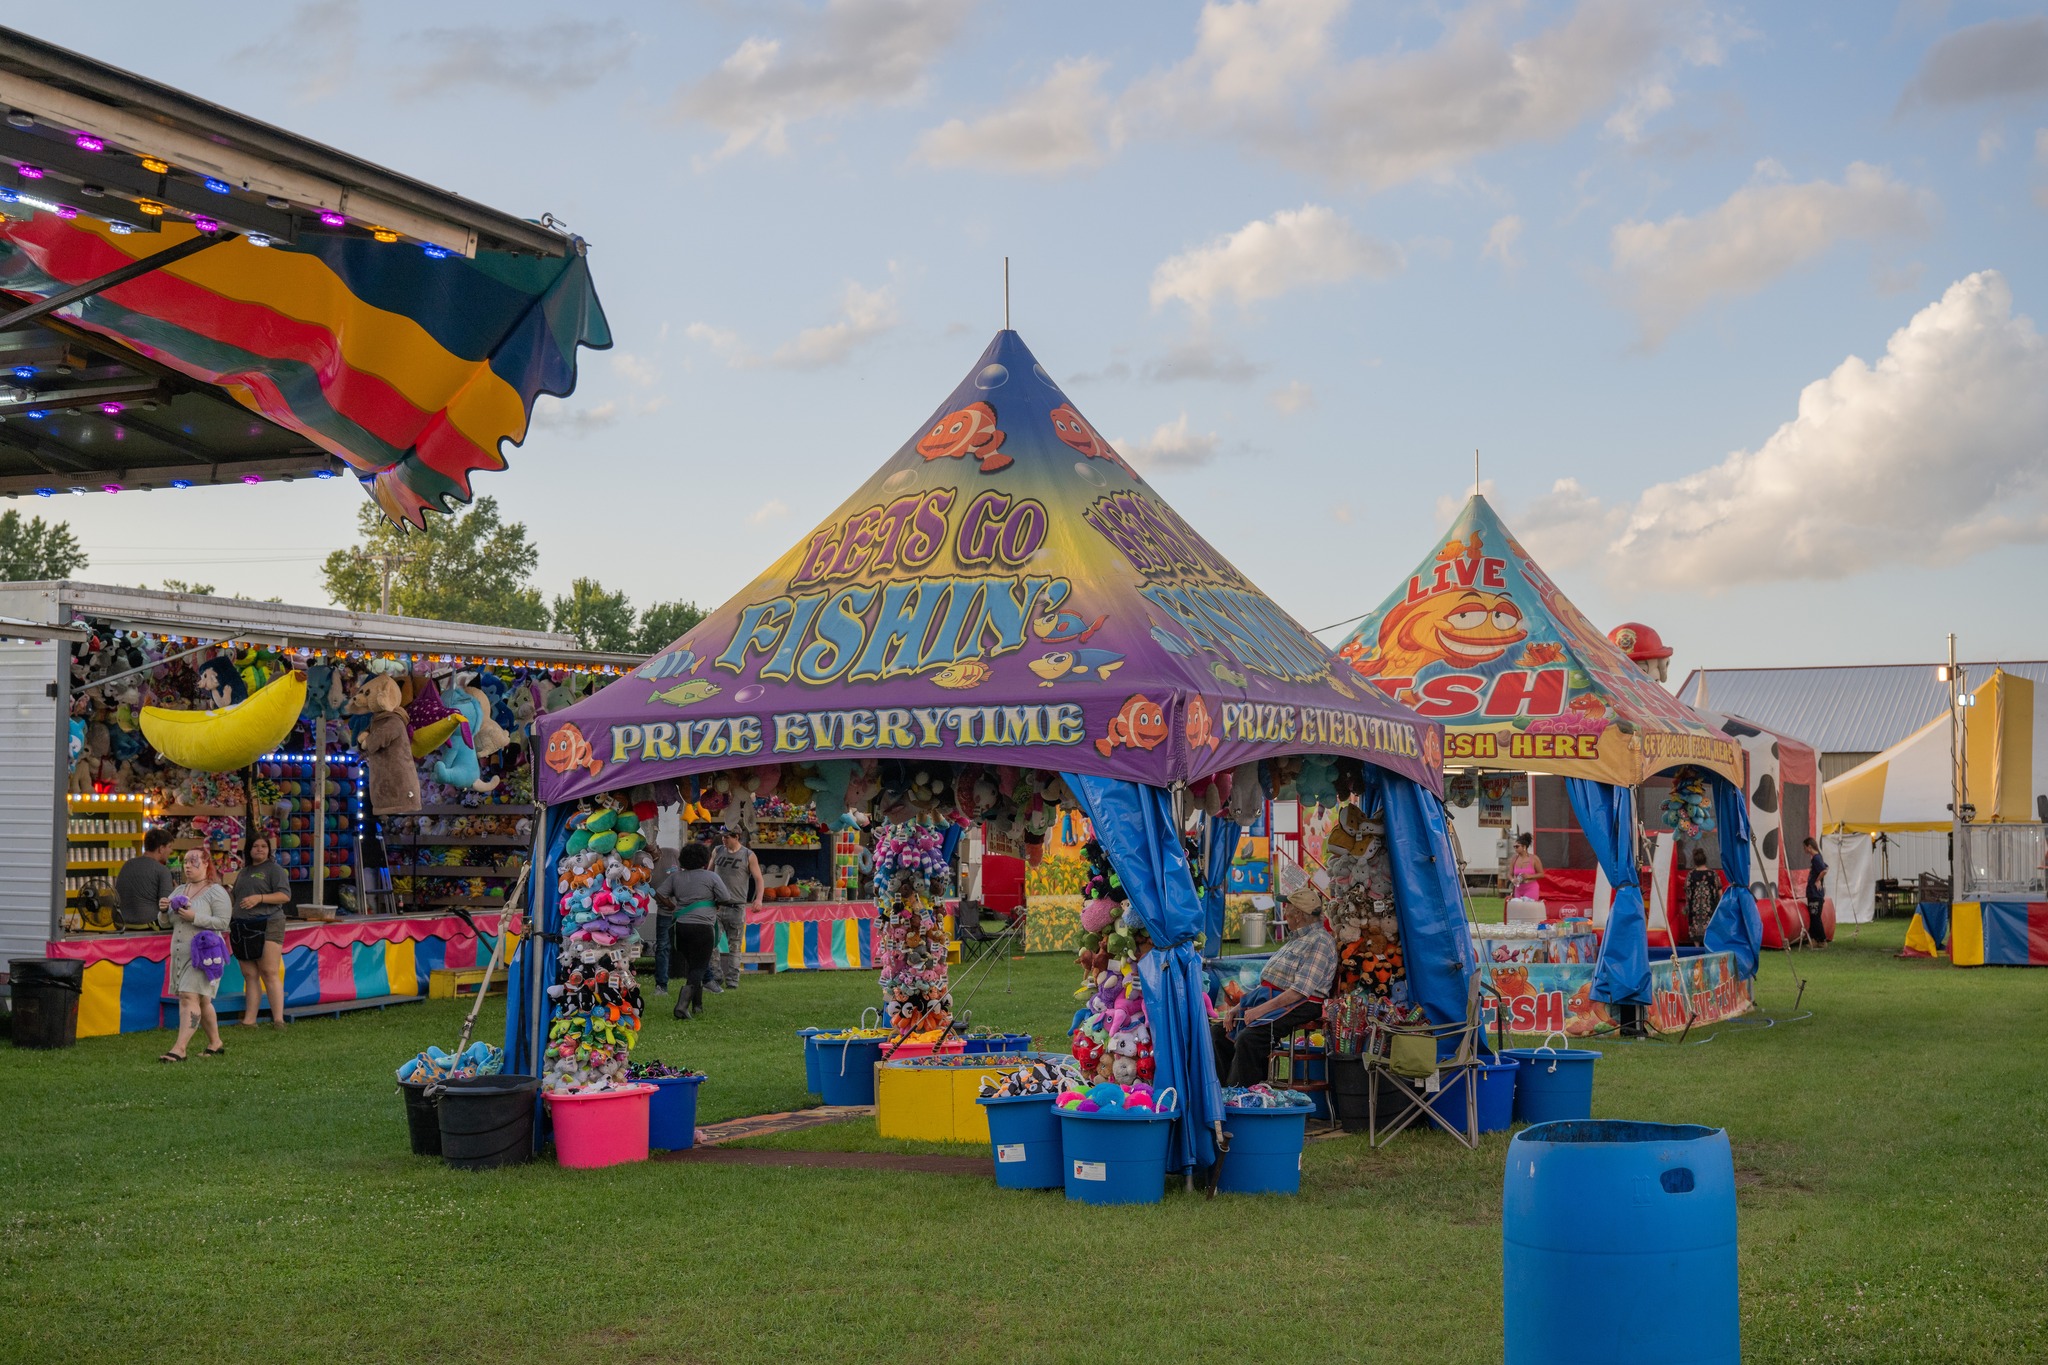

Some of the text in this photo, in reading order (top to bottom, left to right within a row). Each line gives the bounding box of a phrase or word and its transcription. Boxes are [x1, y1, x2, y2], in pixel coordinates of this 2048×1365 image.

[789, 487, 1049, 588] LETS GO
[1405, 556, 1507, 605] LIVE
[715, 574, 1072, 685] FISHIN'
[1370, 668, 1569, 718] ISH
[610, 702, 1086, 763] PRIZE EVERYTIME
[1221, 701, 1419, 758] PRIZE EVERYTIME
[1444, 732, 1599, 760] ISH HERE
[1643, 732, 1734, 765] GET YOUR FISH HERE
[715, 856, 742, 869] UFC
[1483, 991, 1565, 1032] ISH
[1657, 988, 1686, 1029] WIN
[1713, 975, 1738, 1018] FISH
